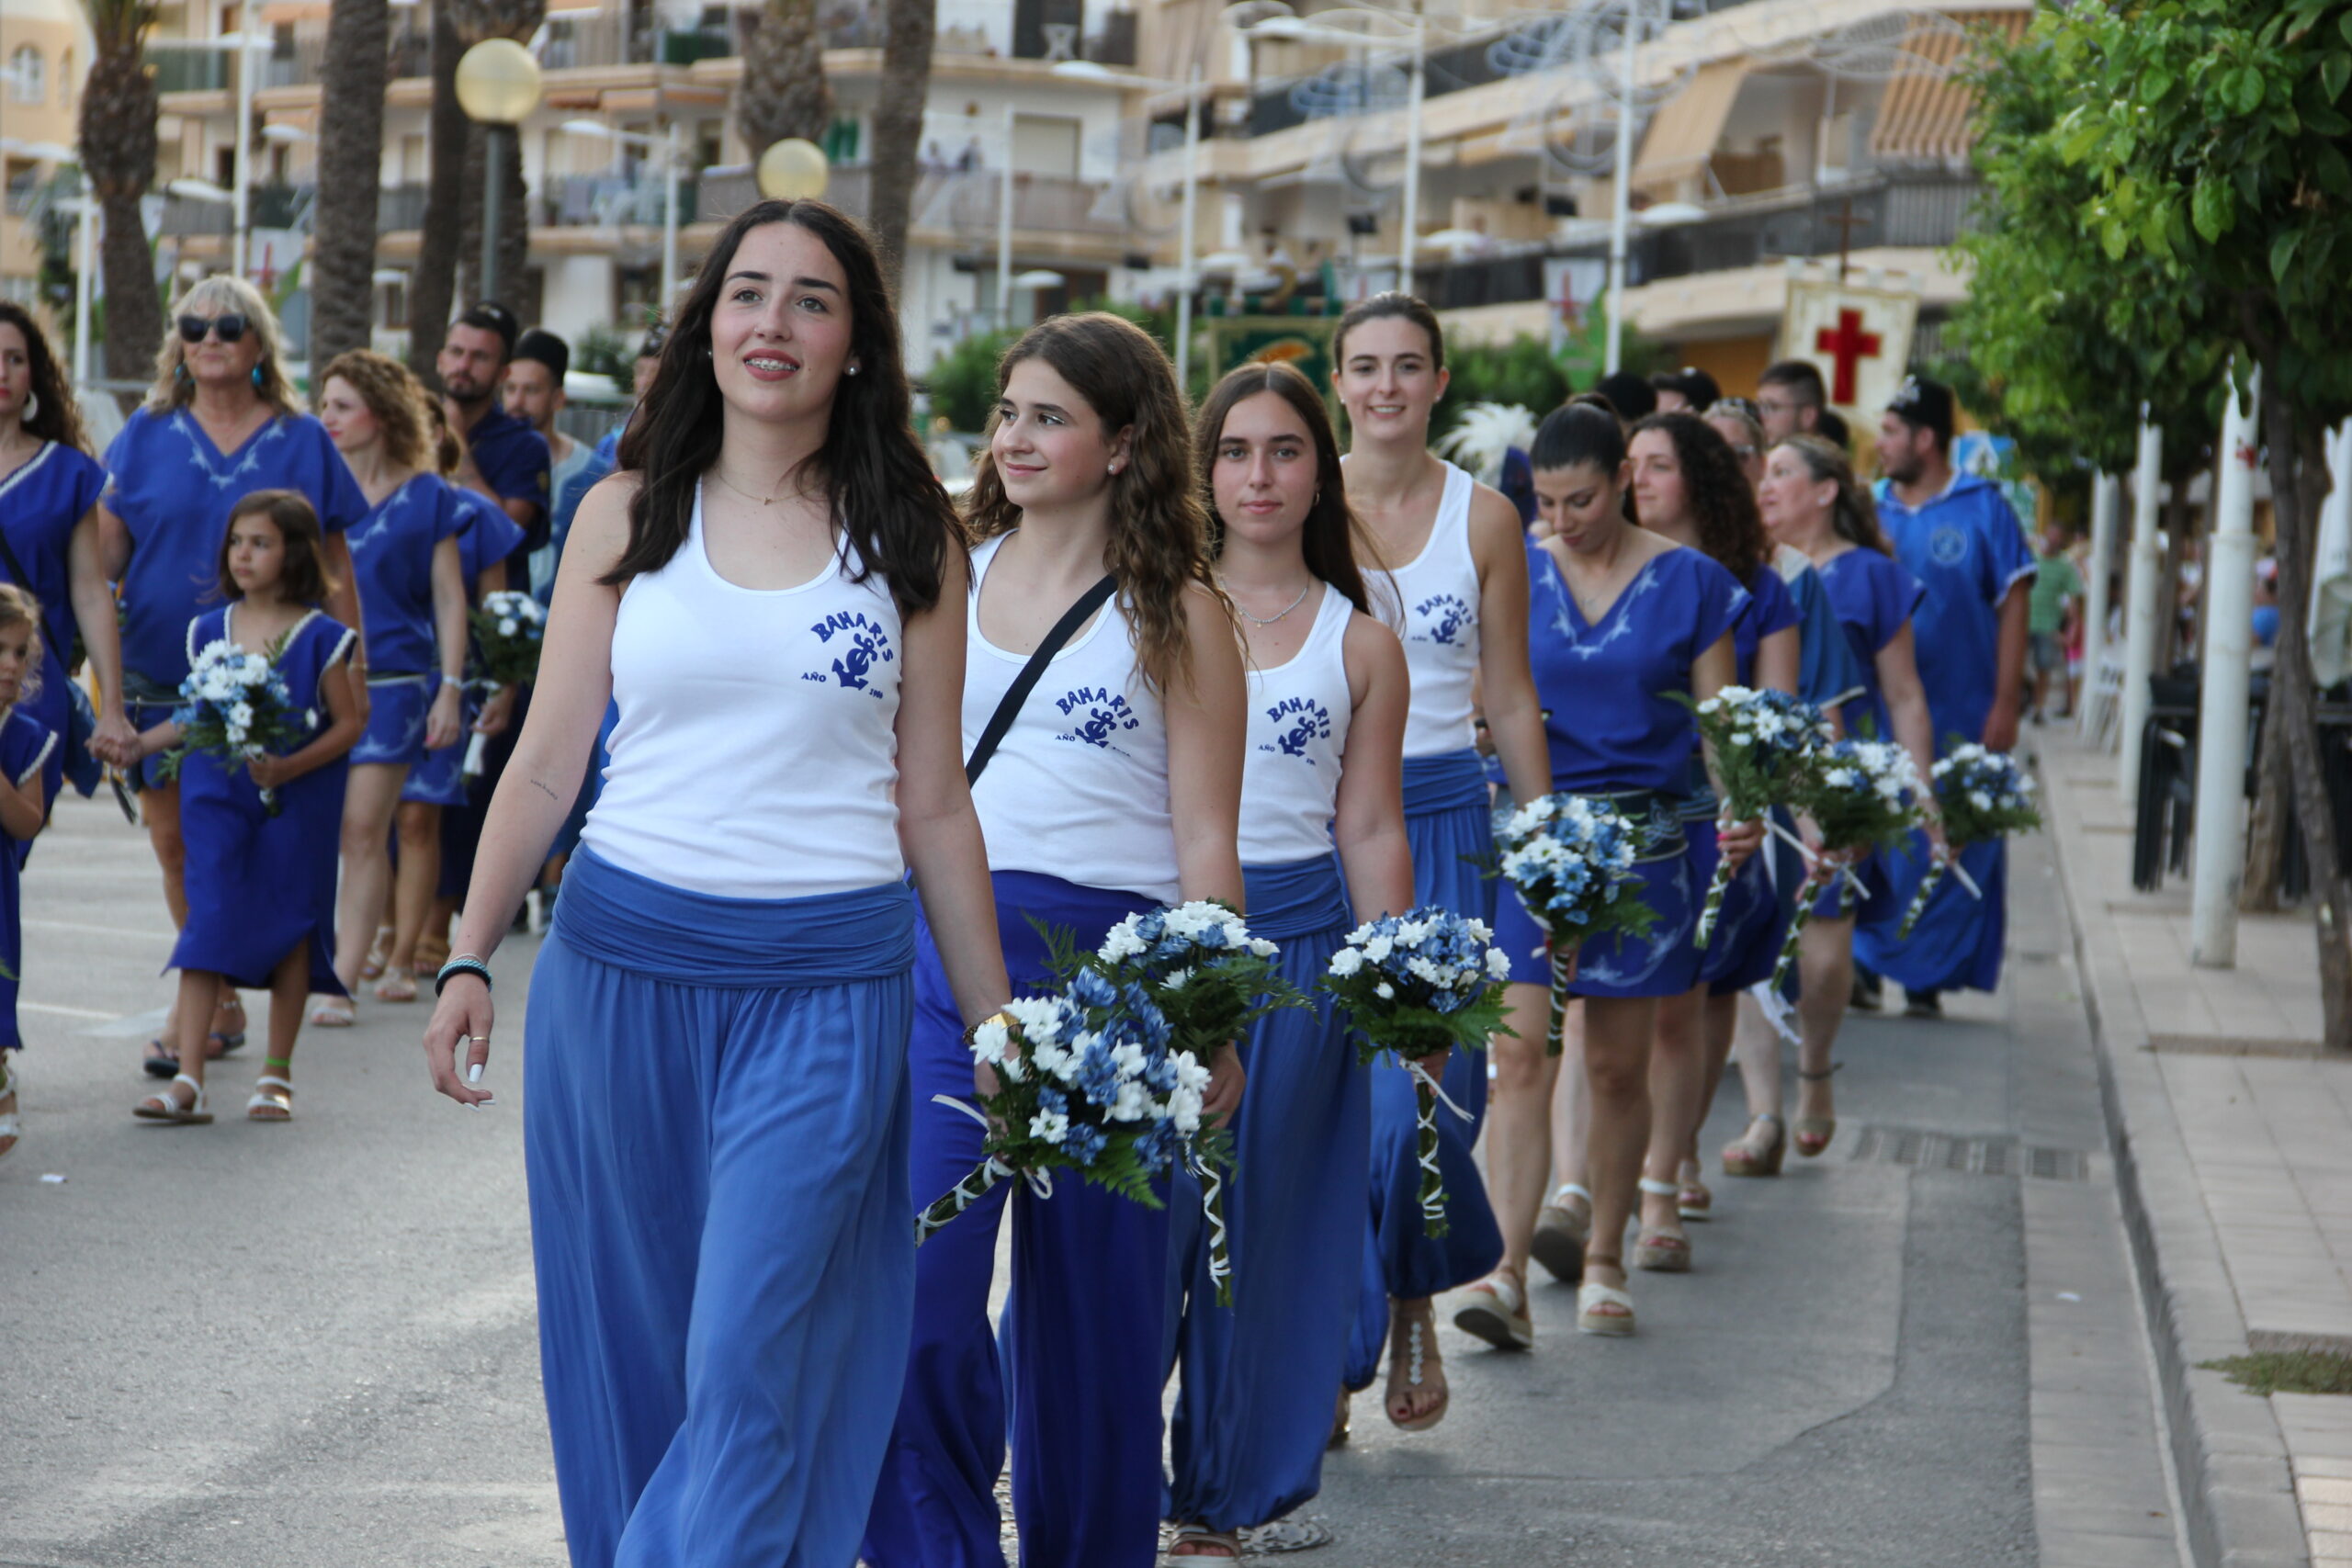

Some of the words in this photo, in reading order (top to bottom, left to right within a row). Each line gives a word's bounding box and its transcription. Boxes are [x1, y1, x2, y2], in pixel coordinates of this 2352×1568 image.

[810, 611, 893, 661] BAHARIS
[801, 671, 826, 682] AÑO
[1056, 687, 1138, 729] BAHARIS
[1266, 697, 1330, 739] BAHARIS
